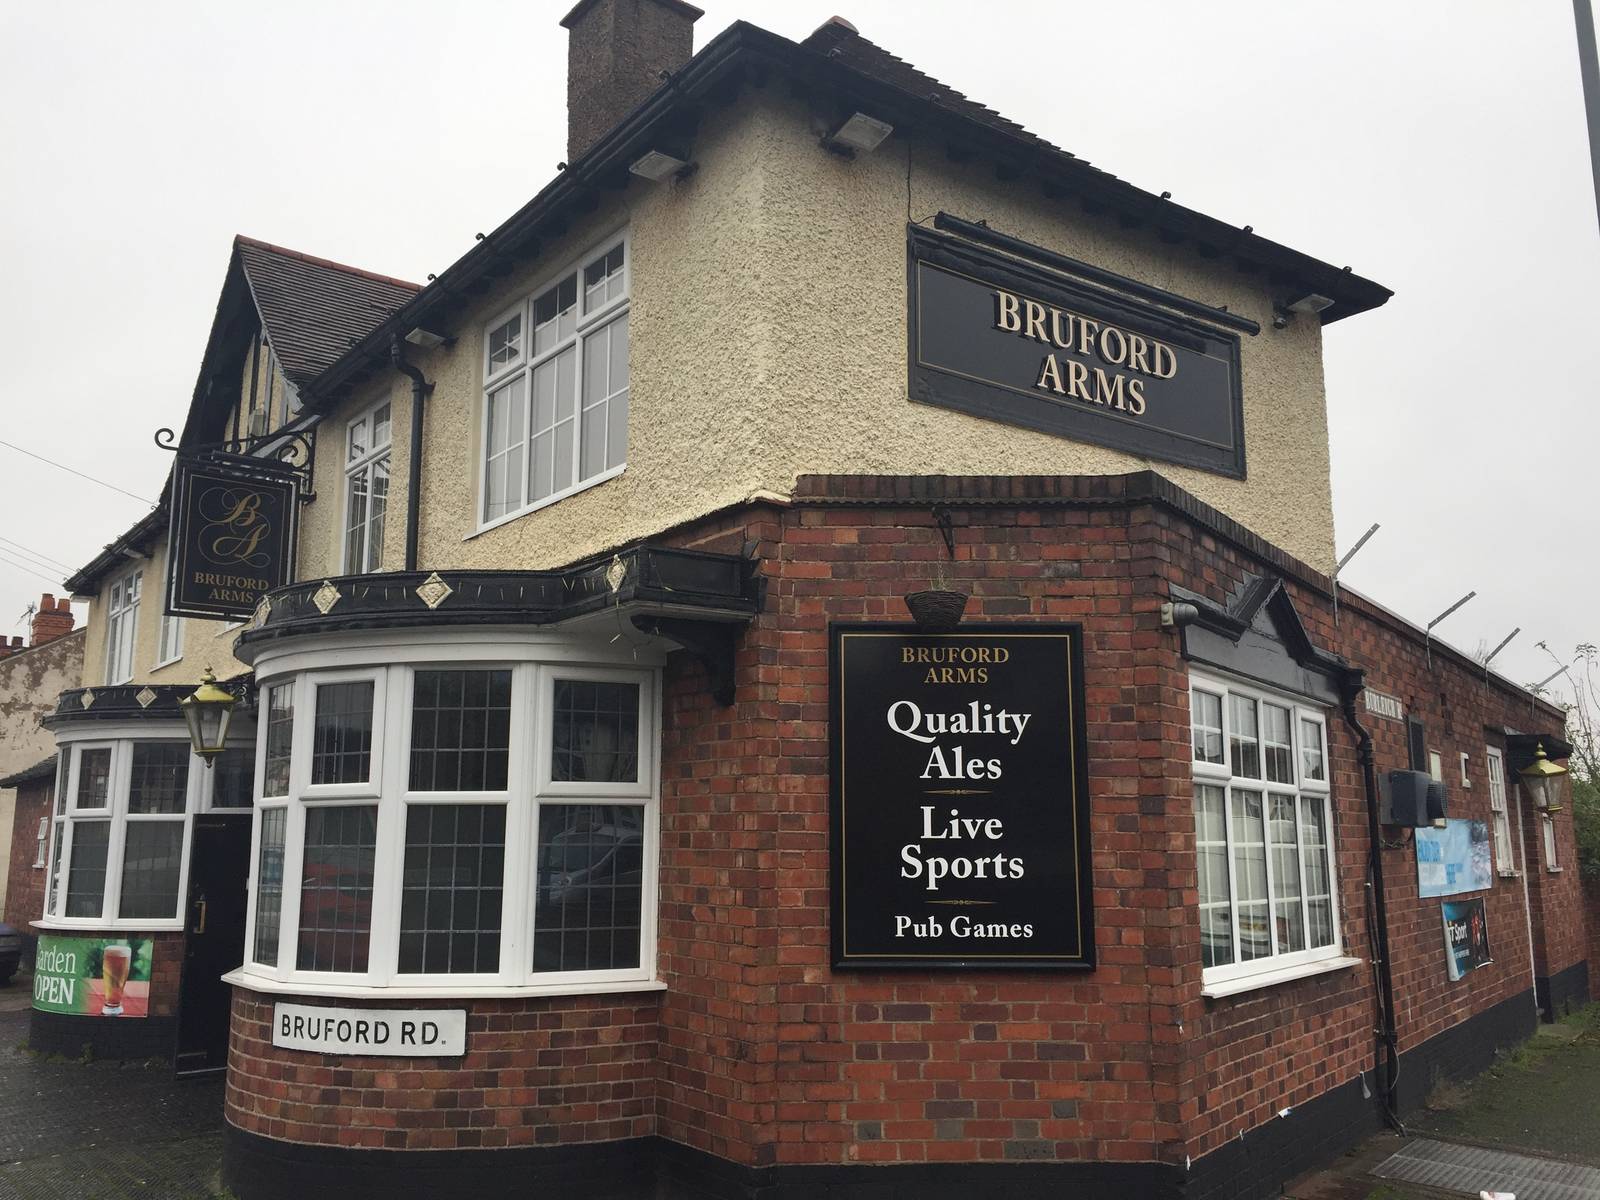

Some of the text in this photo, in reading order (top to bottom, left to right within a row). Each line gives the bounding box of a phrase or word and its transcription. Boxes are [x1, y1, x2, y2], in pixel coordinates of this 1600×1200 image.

[997, 291, 1178, 380] BRUFORD
[1036, 353, 1147, 416] ARMS
[194, 572, 269, 590] BRUFORD
[209, 588, 253, 604] ARMS
[902, 647, 1010, 664] BRUFORD
[923, 667, 989, 684] ARMS
[886, 700, 1032, 745] Quality
[919, 745, 1003, 780] Ales
[919, 805, 1004, 840] Live
[900, 844, 1025, 890] Sports
[894, 915, 1034, 938] Pub Games
[34, 974, 76, 1005] OPEN
[281, 1014, 390, 1045] BRUFORD
